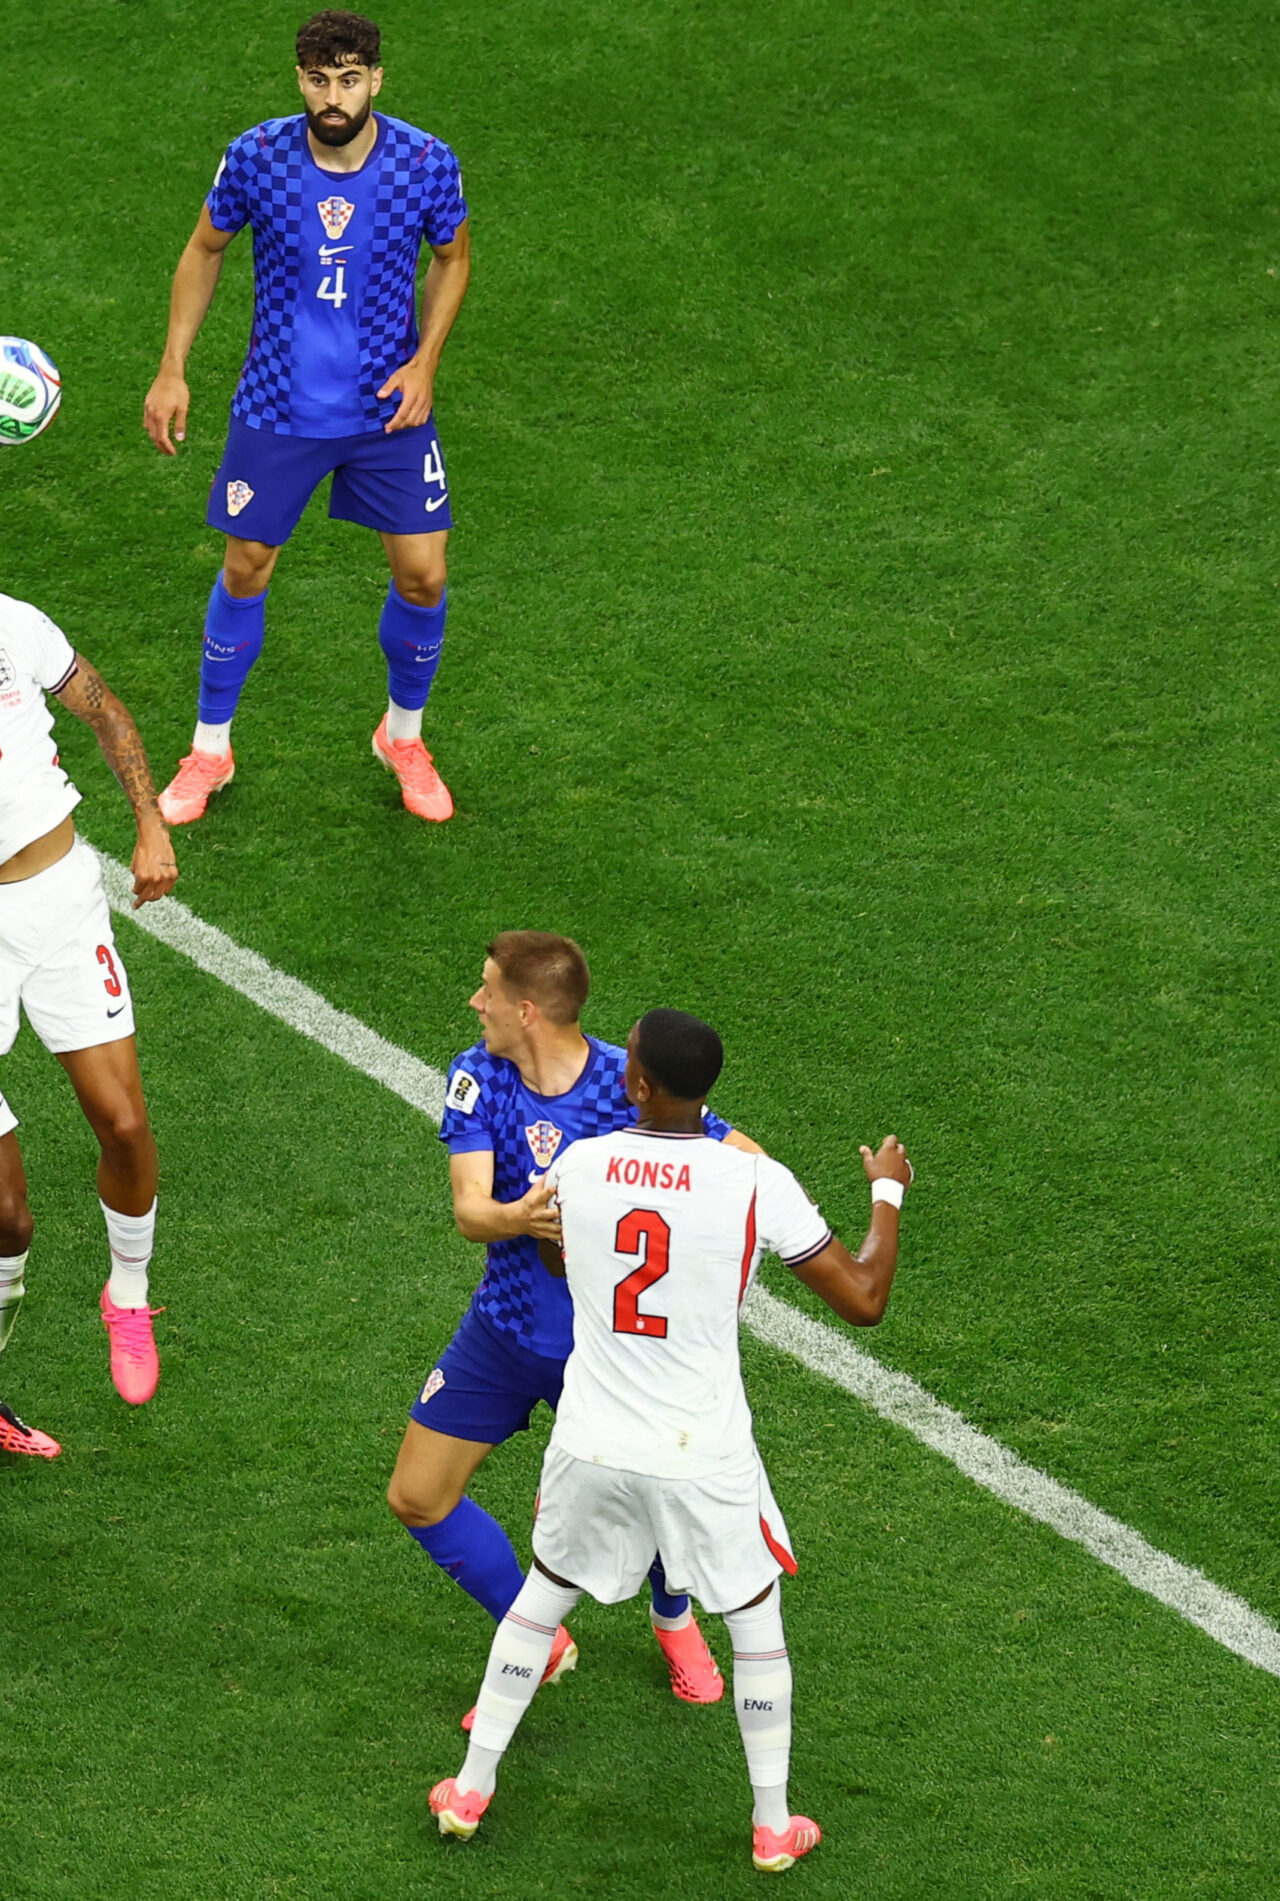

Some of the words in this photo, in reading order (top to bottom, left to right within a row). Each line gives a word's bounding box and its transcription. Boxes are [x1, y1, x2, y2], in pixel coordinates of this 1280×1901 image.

[316, 266, 347, 308] 4
[423, 440, 446, 490] 4
[95, 943, 122, 997] 3
[605, 1157, 691, 1192] KONSA
[613, 1207, 671, 1340] 2
[501, 1664, 533, 1680] ENG
[743, 1698, 773, 1713] ENG
